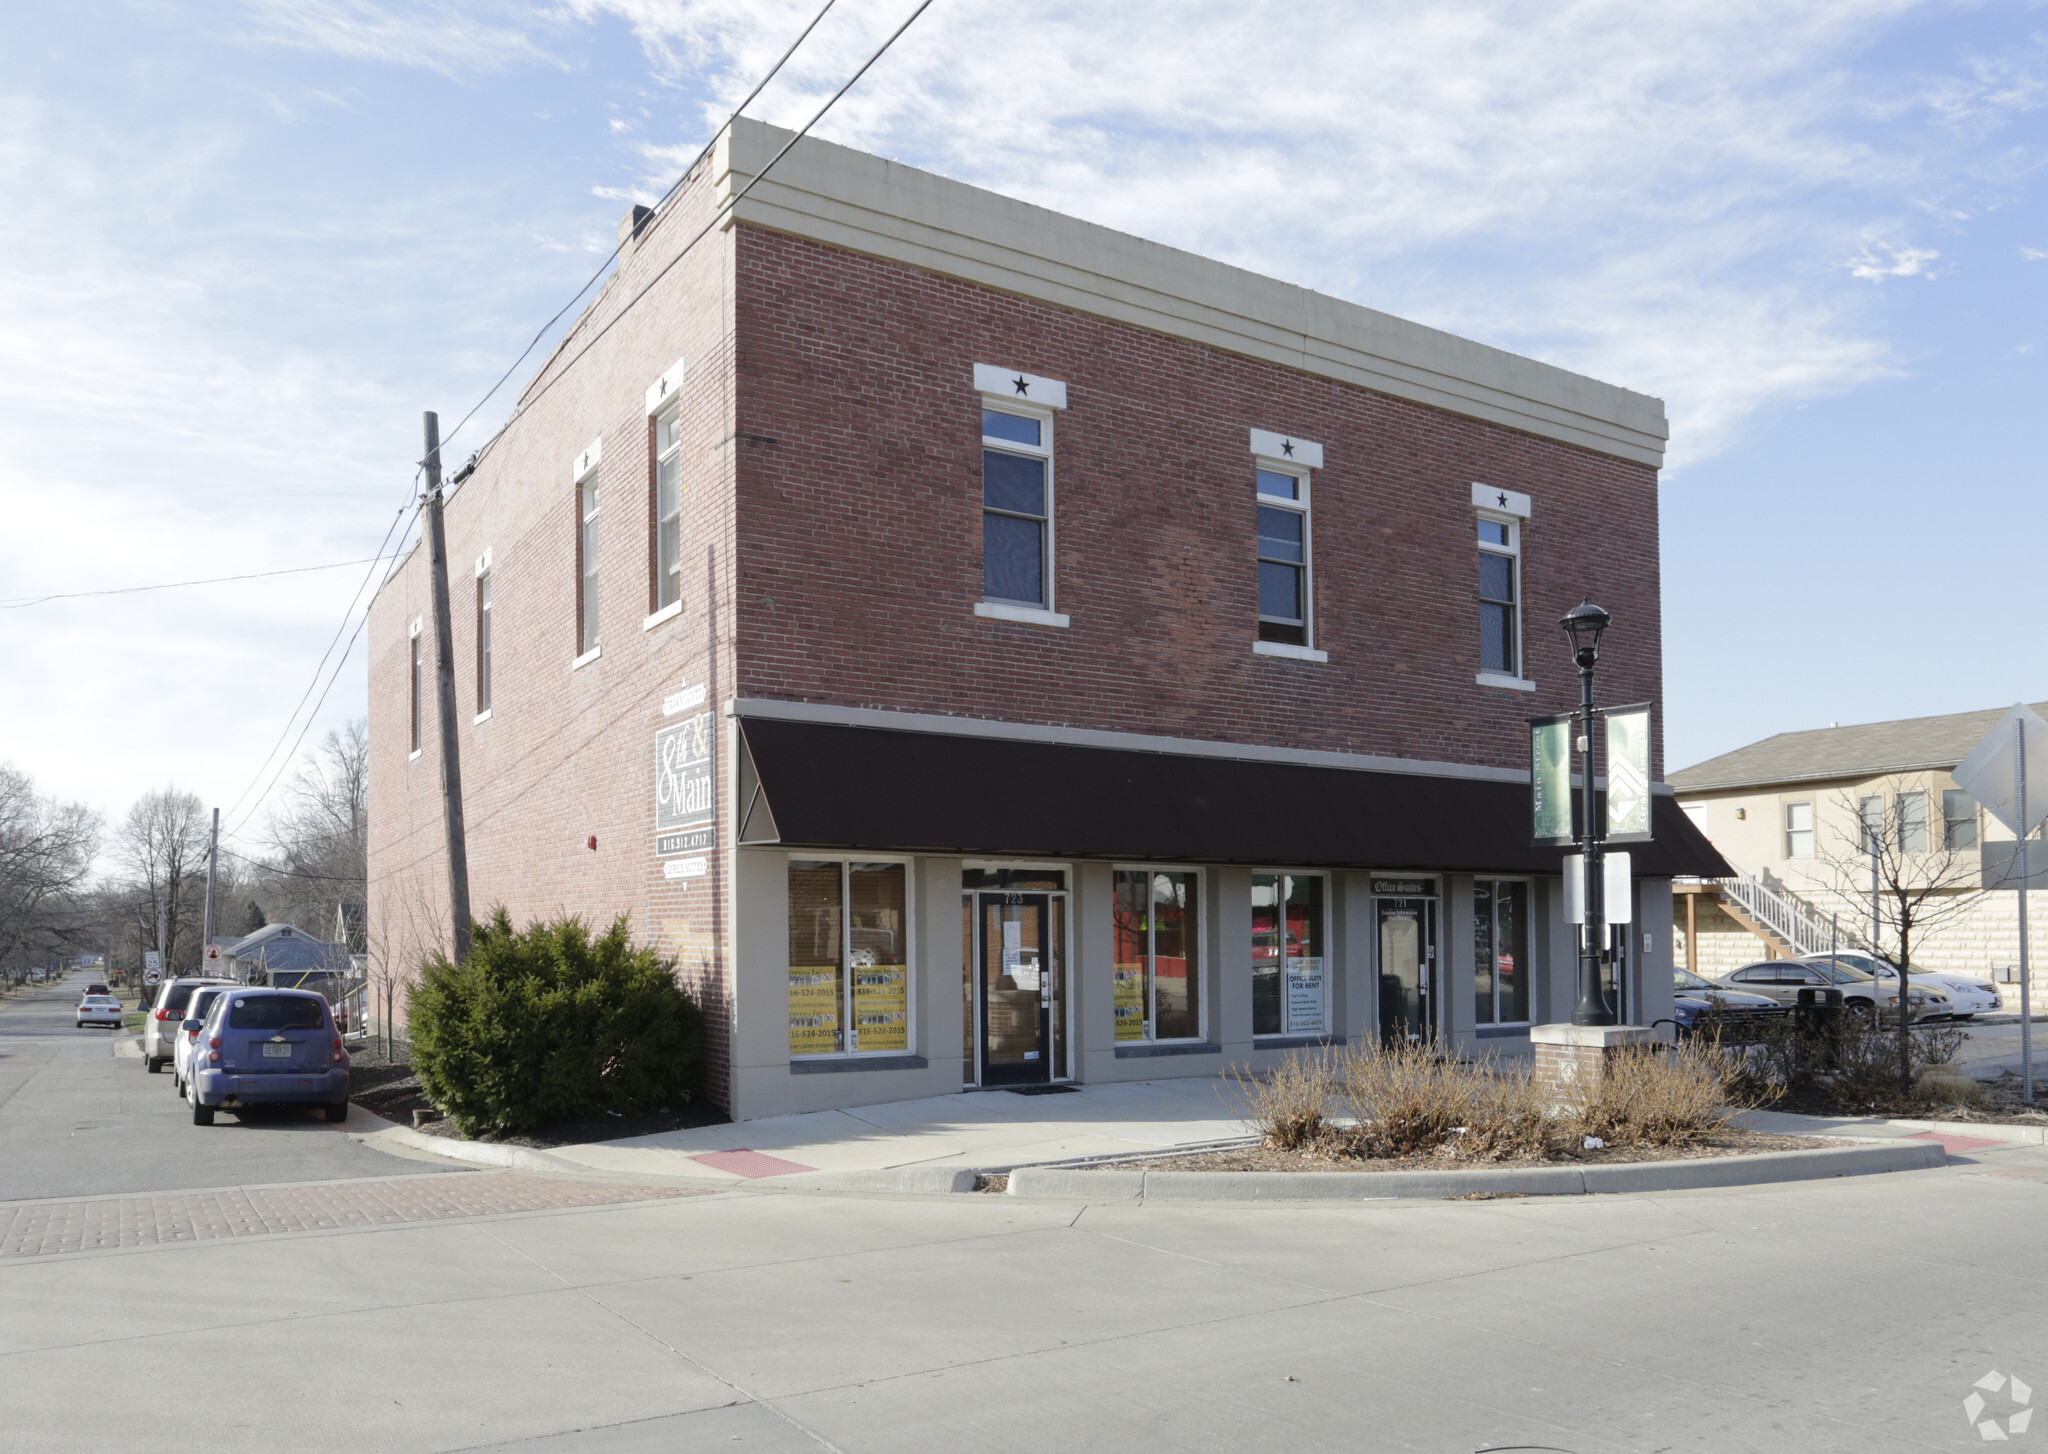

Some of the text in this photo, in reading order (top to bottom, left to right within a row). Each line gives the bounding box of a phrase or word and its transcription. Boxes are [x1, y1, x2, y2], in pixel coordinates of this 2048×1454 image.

[692, 712, 710, 757] &
[672, 767, 712, 816] Main
[1374, 881, 1421, 892] Office Suites
[1004, 893, 1024, 904] 723
[1394, 898, 1407, 908] 721
[147, 959, 158, 967] 25
[789, 989, 834, 997] 16-524-2015
[857, 987, 905, 995] 816-524-2015
[789, 1029, 836, 1038] 16-524-2015
[857, 1026, 905, 1035] 816-524-2015
